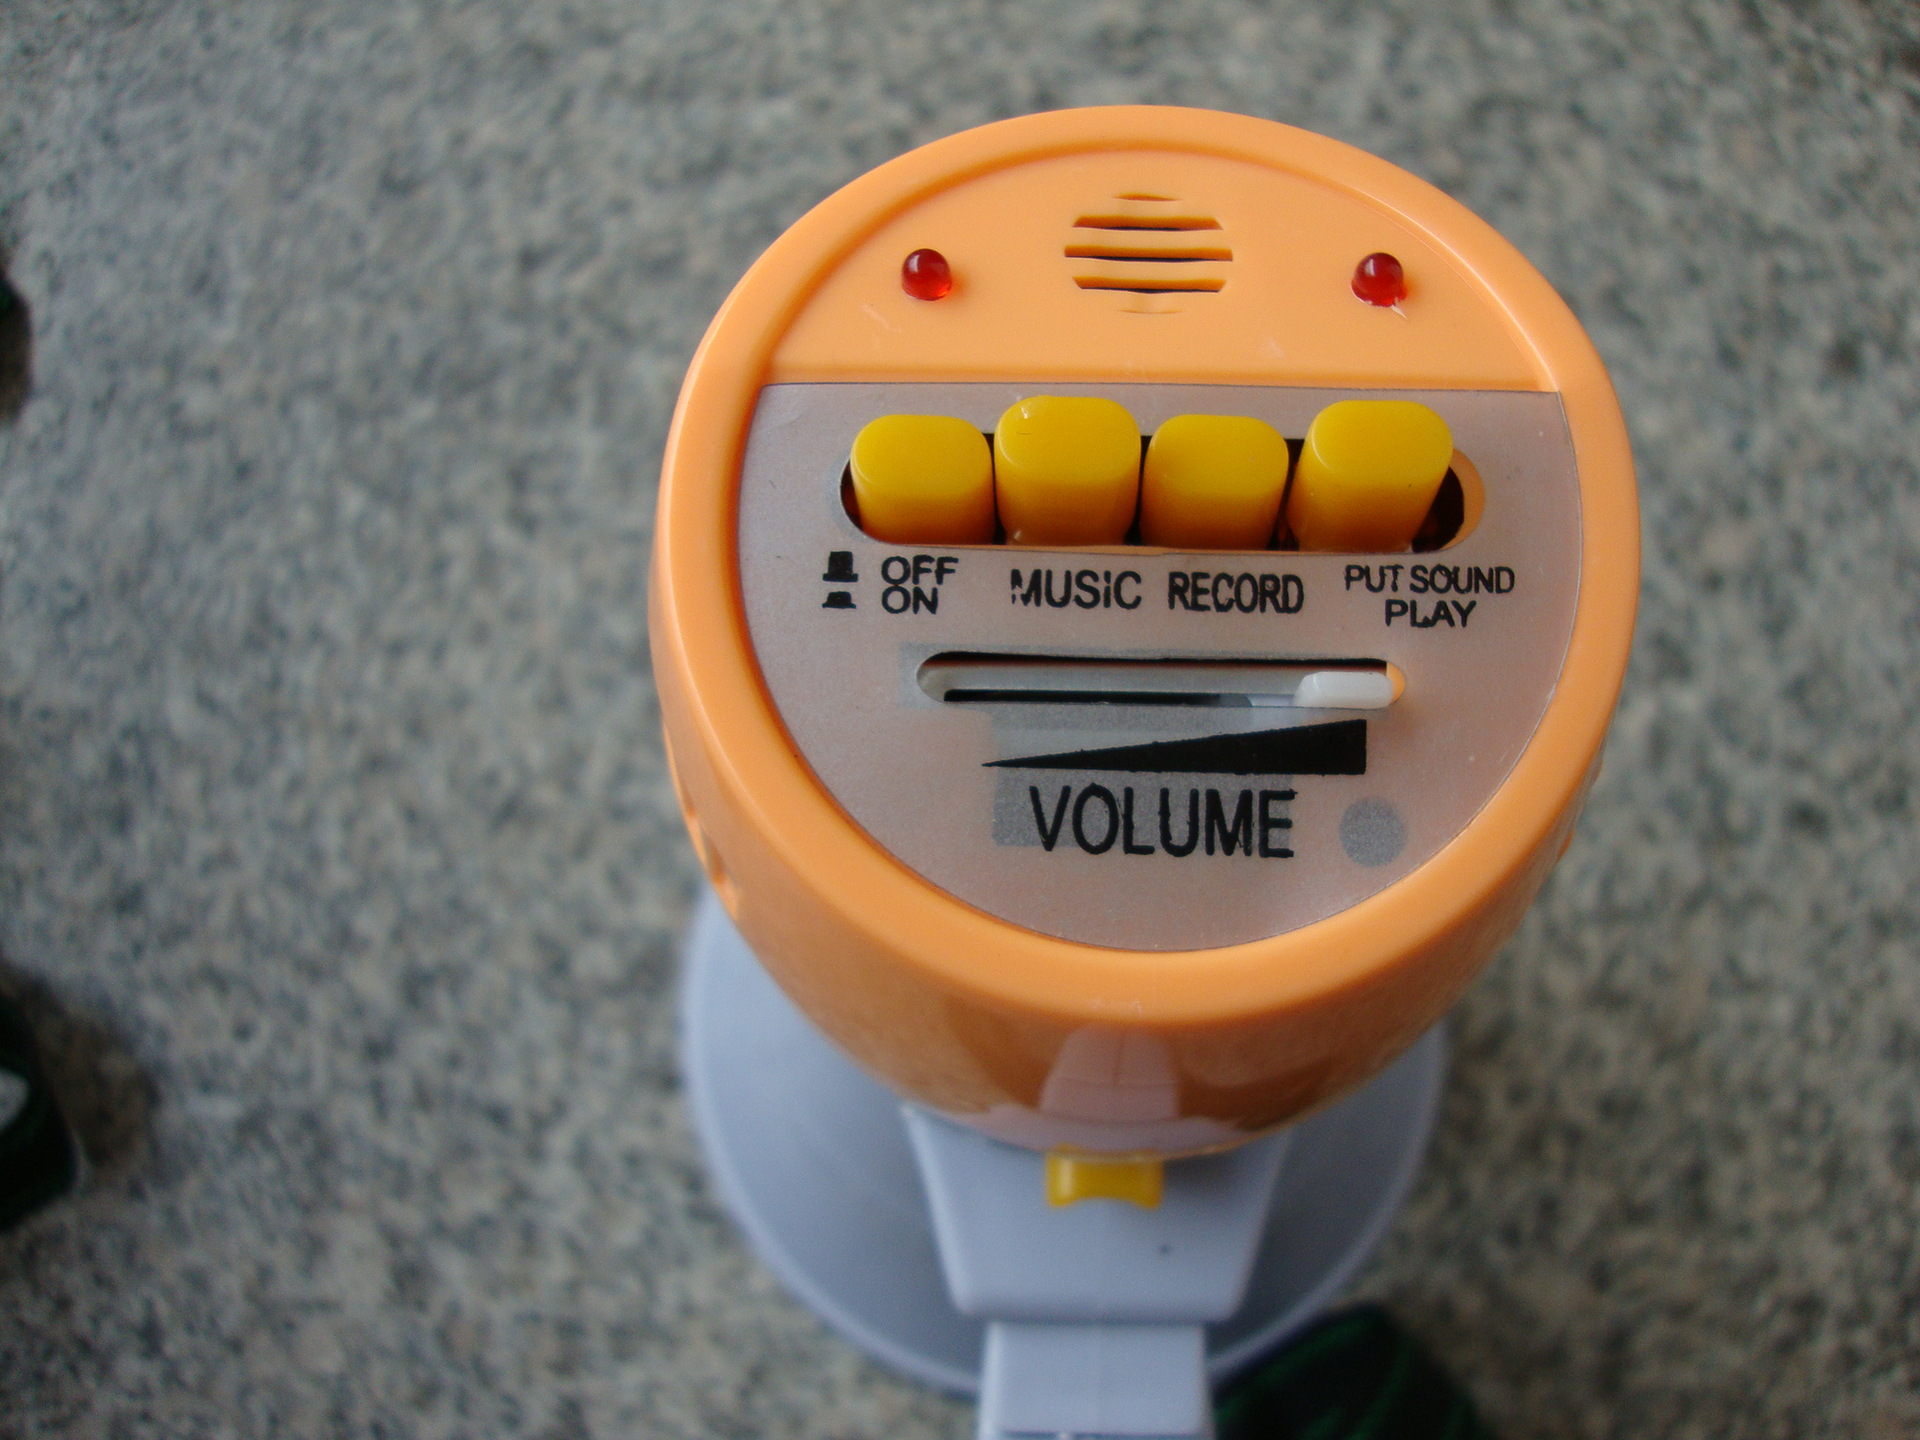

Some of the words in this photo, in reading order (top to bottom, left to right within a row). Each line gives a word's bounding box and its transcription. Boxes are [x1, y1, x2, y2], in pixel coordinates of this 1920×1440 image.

[881, 554, 959, 586] OFF
[1345, 564, 1404, 593] PUT
[1410, 563, 1515, 594] SOUND
[881, 585, 938, 615] ON
[1010, 568, 1142, 610] MUSIC
[1168, 570, 1305, 614] RECORD
[1384, 598, 1477, 628] PLAY
[1029, 782, 1298, 858] VOLUME
